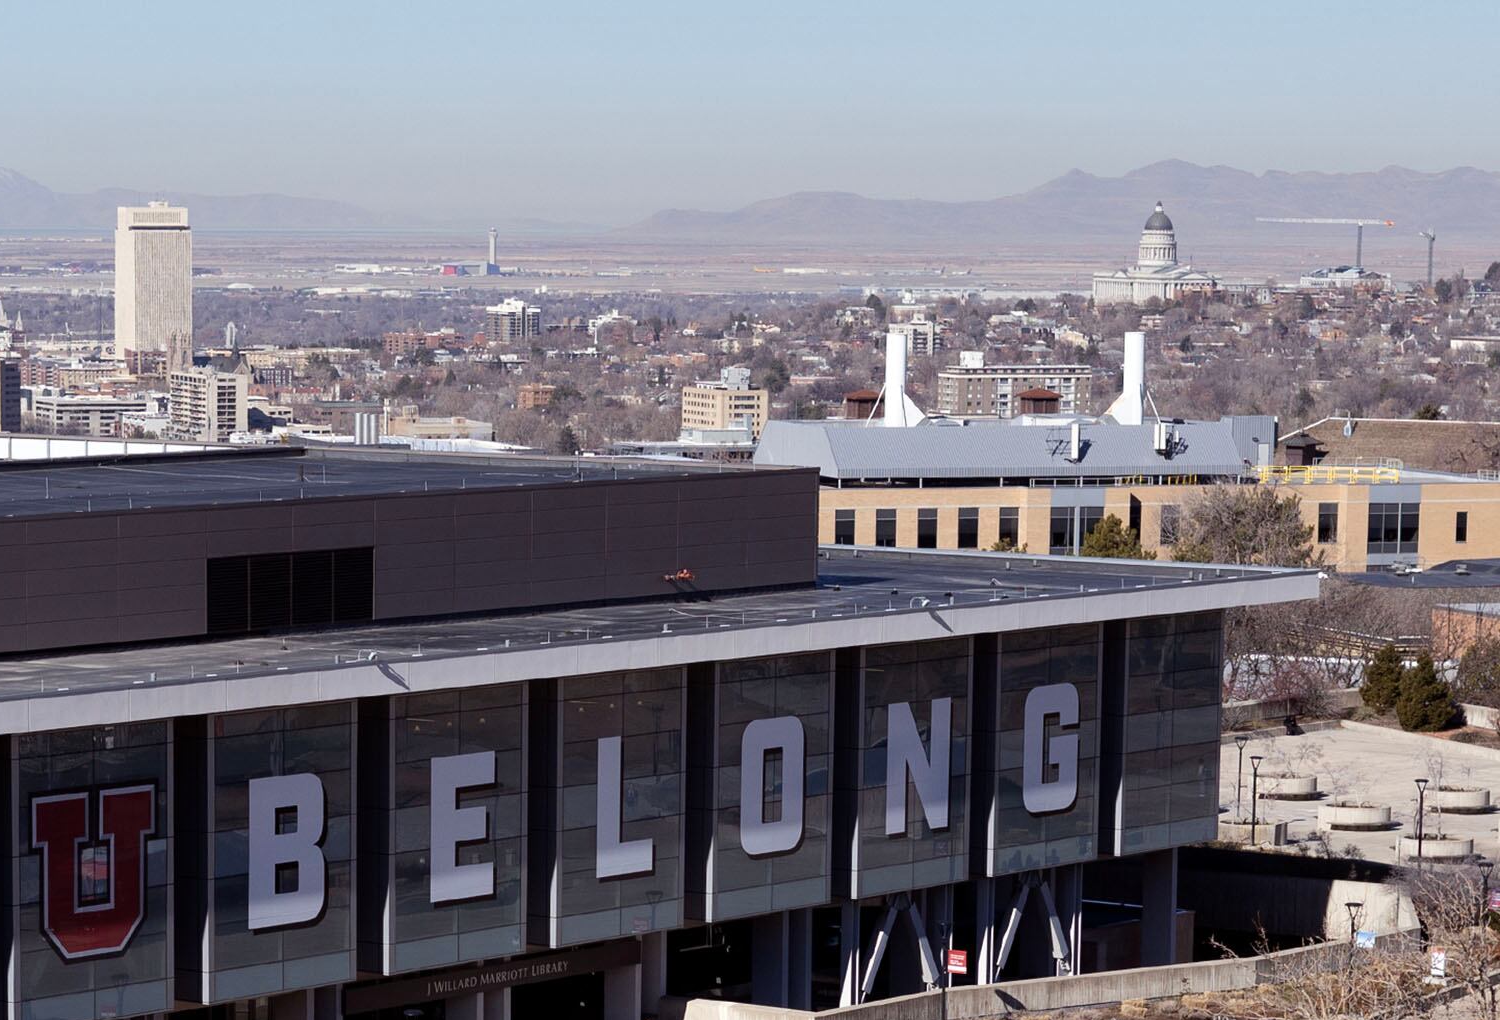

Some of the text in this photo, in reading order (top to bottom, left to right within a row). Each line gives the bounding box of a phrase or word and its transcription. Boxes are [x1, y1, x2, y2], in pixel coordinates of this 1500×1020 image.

[30, 683, 1079, 961] U BELONG
[427, 961, 569, 996] J WILLARD MARRIOTT LIBRARY
